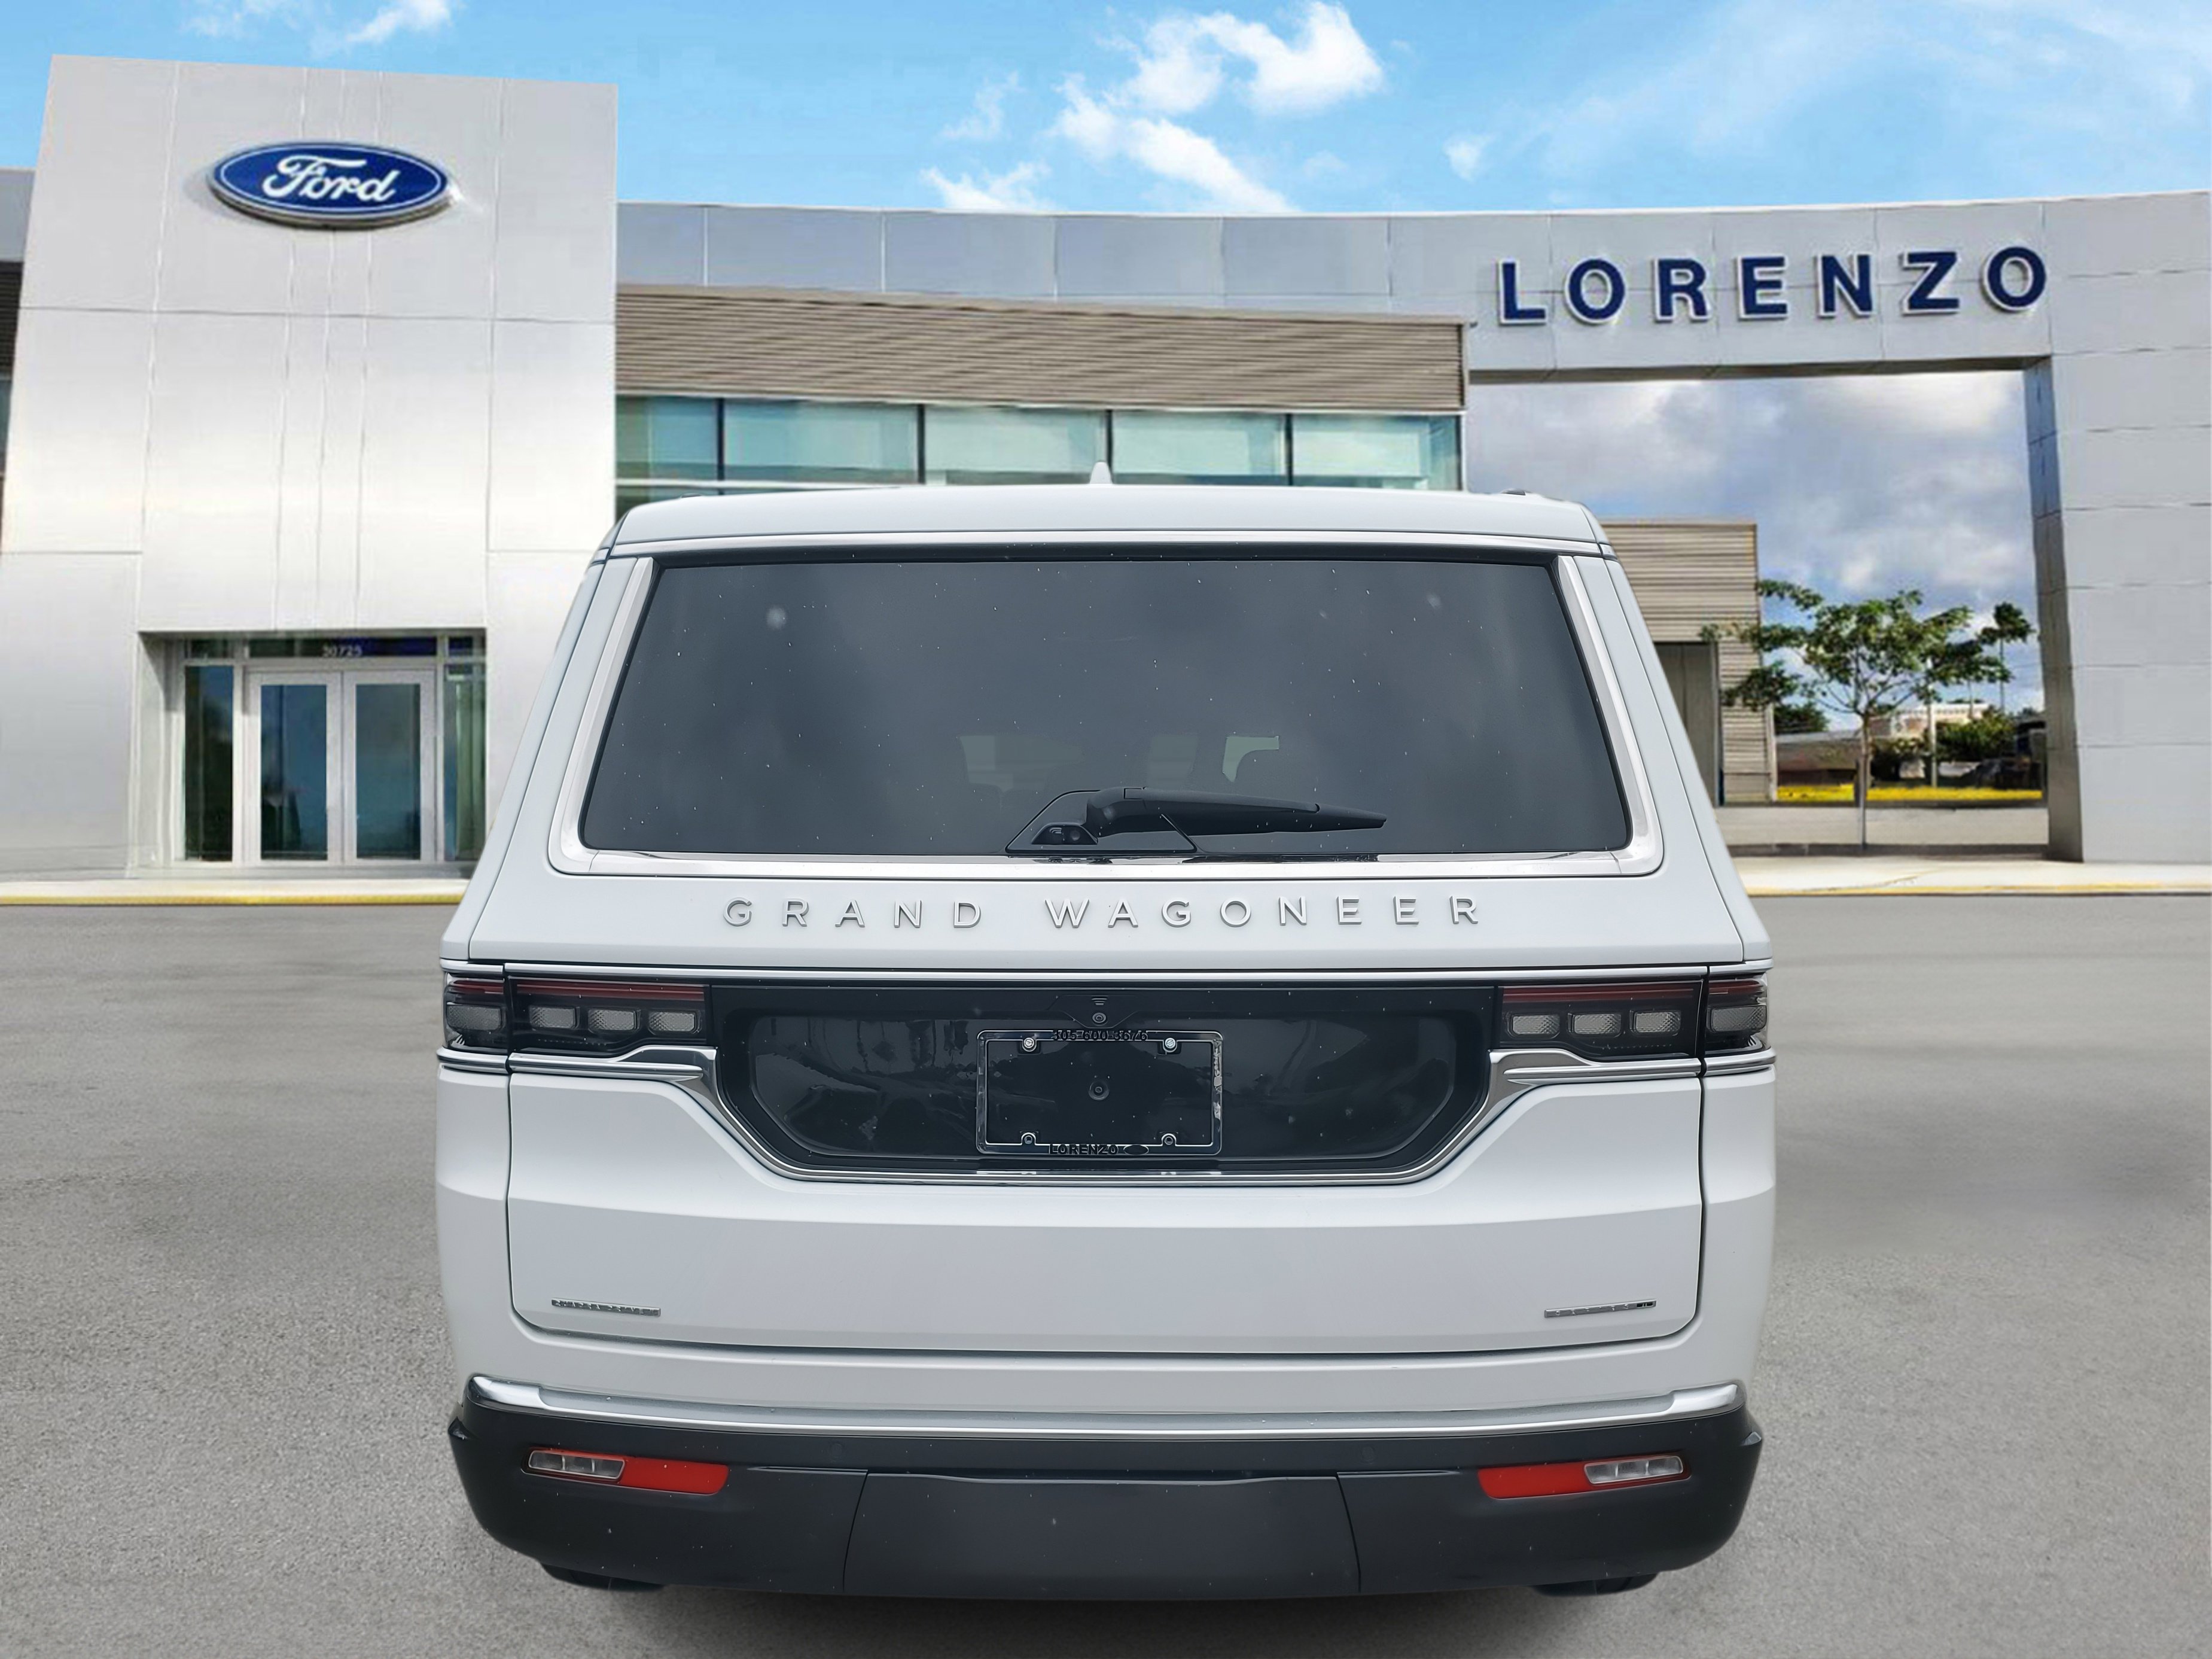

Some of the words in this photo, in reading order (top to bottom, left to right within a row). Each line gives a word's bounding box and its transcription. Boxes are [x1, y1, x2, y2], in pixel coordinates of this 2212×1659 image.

[263, 154, 401, 202] Ford
[1498, 246, 2047, 325] LORENZO
[722, 897, 982, 929] GRAND
[1044, 896, 1478, 929] WAGONEER
[1049, 1144, 1119, 1155] LORENZO
